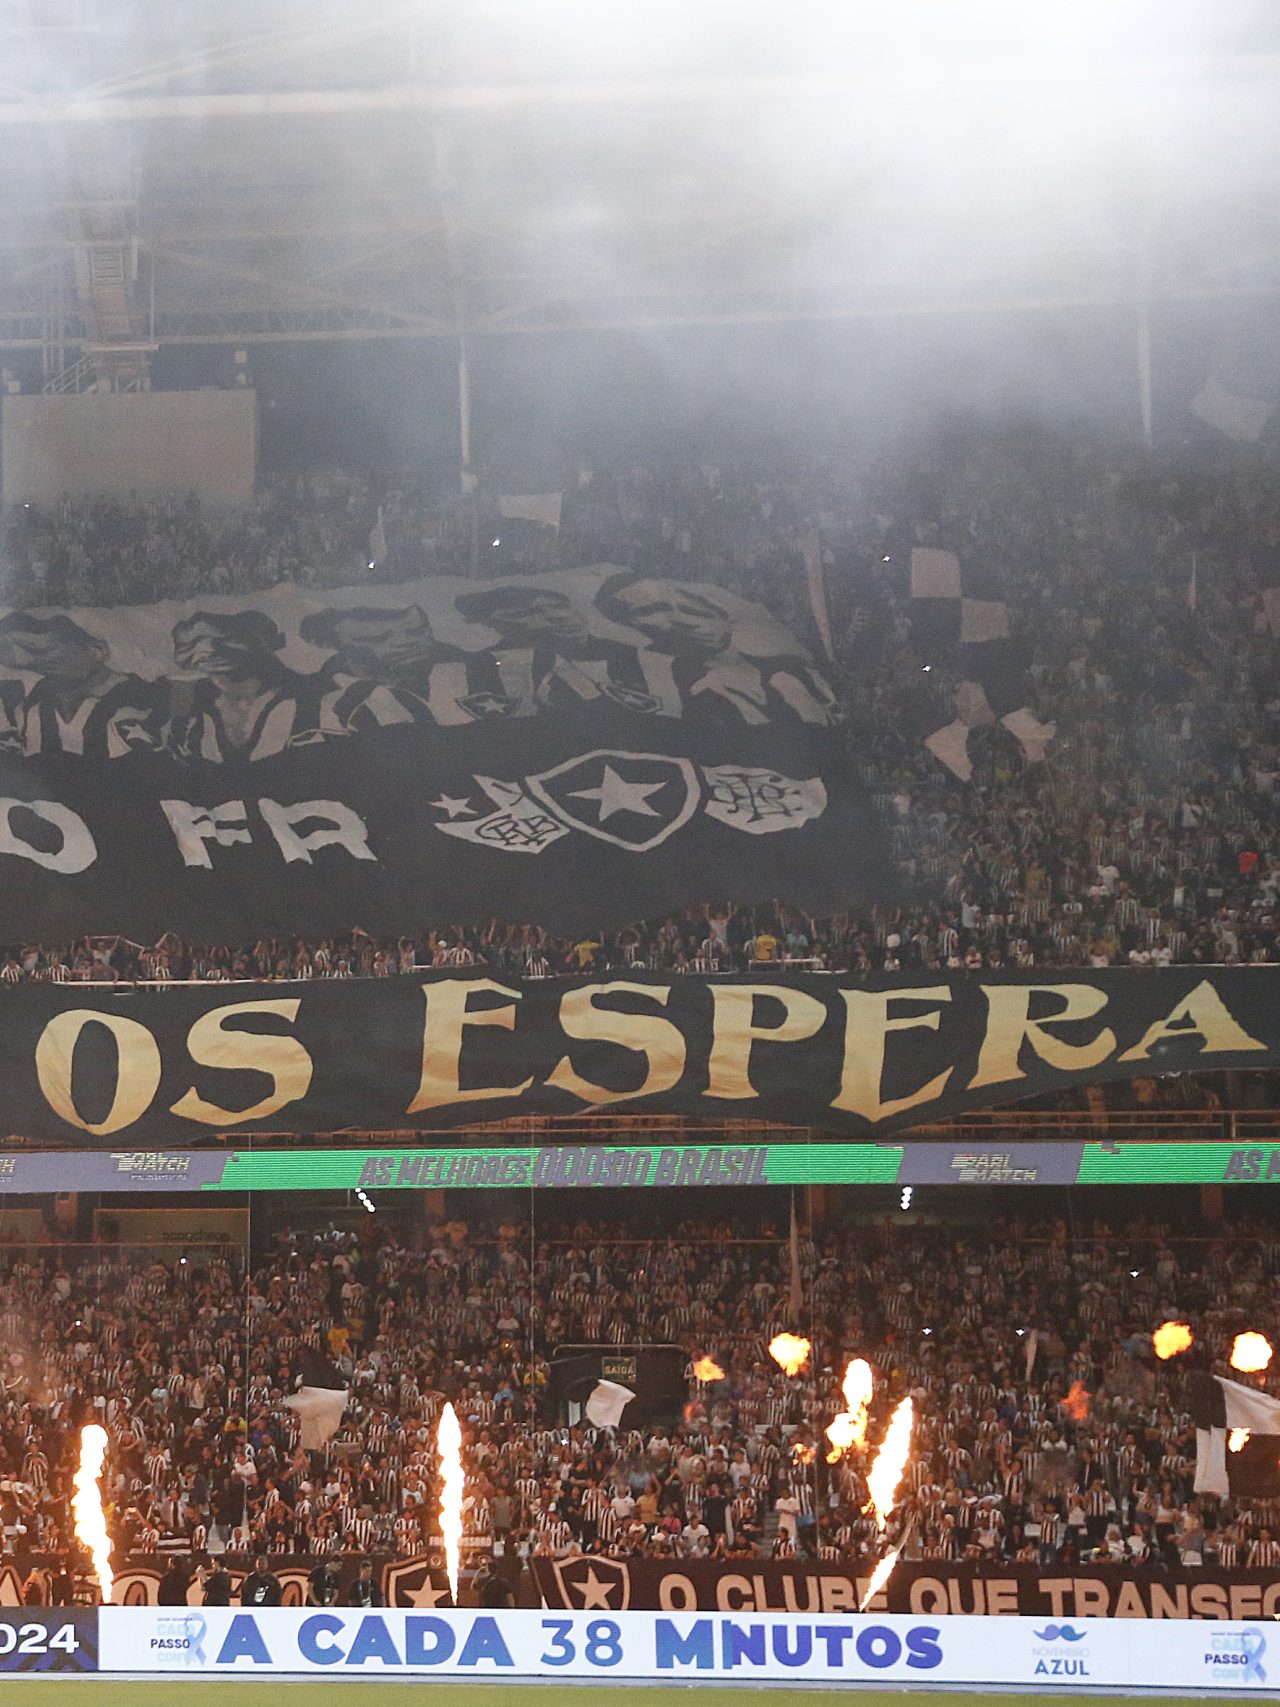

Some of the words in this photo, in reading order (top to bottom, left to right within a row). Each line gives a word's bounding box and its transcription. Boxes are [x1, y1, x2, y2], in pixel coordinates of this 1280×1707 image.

[160, 798, 378, 869] FR
[35, 996, 314, 1137] OS
[406, 979, 1268, 1124] ESPERA
[358, 1156, 394, 1185] AS
[397, 1156, 531, 1185] MELHORES
[653, 1148, 769, 1185] BRASIL
[1224, 1150, 1264, 1179] AS
[659, 1574, 698, 1612] O
[910, 1577, 1019, 1616] QUE
[150, 1638, 190, 1649] PASSO
[216, 1614, 273, 1664] A
[298, 1613, 516, 1666] CADA
[540, 1619, 624, 1667] 38
[1035, 1659, 1090, 1676] AZUL
[1205, 1653, 1249, 1665] PASSO
